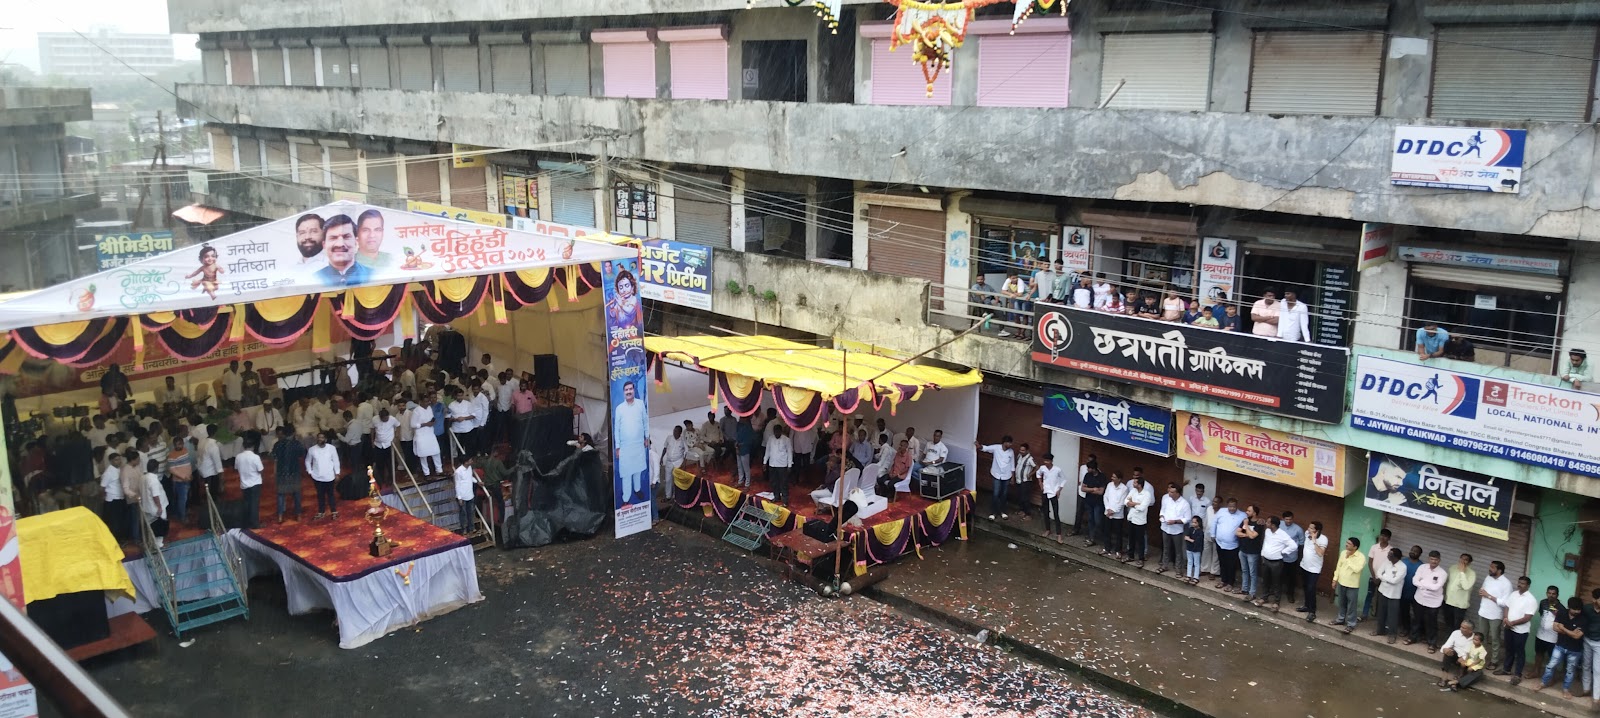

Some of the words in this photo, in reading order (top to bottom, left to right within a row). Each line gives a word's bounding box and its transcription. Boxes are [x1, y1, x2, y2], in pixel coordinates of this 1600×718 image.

[1397, 139, 1464, 157] DTDC
[227, 240, 269, 256] जनसेवा
[430, 228, 508, 258] दहिहंडी
[228, 258, 276, 274] प्रतिष्ठान
[437, 250, 506, 273] उत्सव
[508, 248, 546, 261] २०२४
[1203, 263, 1232, 277] छत्रपती
[230, 278, 269, 296] मुरबाड
[1089, 327, 1187, 372] छत्रपती
[1189, 347, 1266, 381] ग्राफिक्स
[1360, 374, 1422, 400] DTDC
[1510, 386, 1582, 411] Trackon
[1072, 393, 1131, 436] पंखुडी
[1128, 417, 1165, 433] कलेक्शन
[1487, 408, 1521, 421] LOCAL,
[1524, 415, 1573, 430] NATIONAL
[1207, 421, 1240, 443] निशा
[1244, 433, 1308, 459] कलेक्शन
[1353, 417, 1366, 426] Mr.
[1367, 419, 1405, 435] JAYWANT
[1407, 428, 1447, 443] GAIKWAD
[1453, 438, 1503, 455] 8097962754
[1503, 438, 1523, 446] Behind
[1524, 442, 1551, 452] Congress
[1418, 464, 1499, 506] निहाल
[1468, 505, 1501, 522] पार्लर
